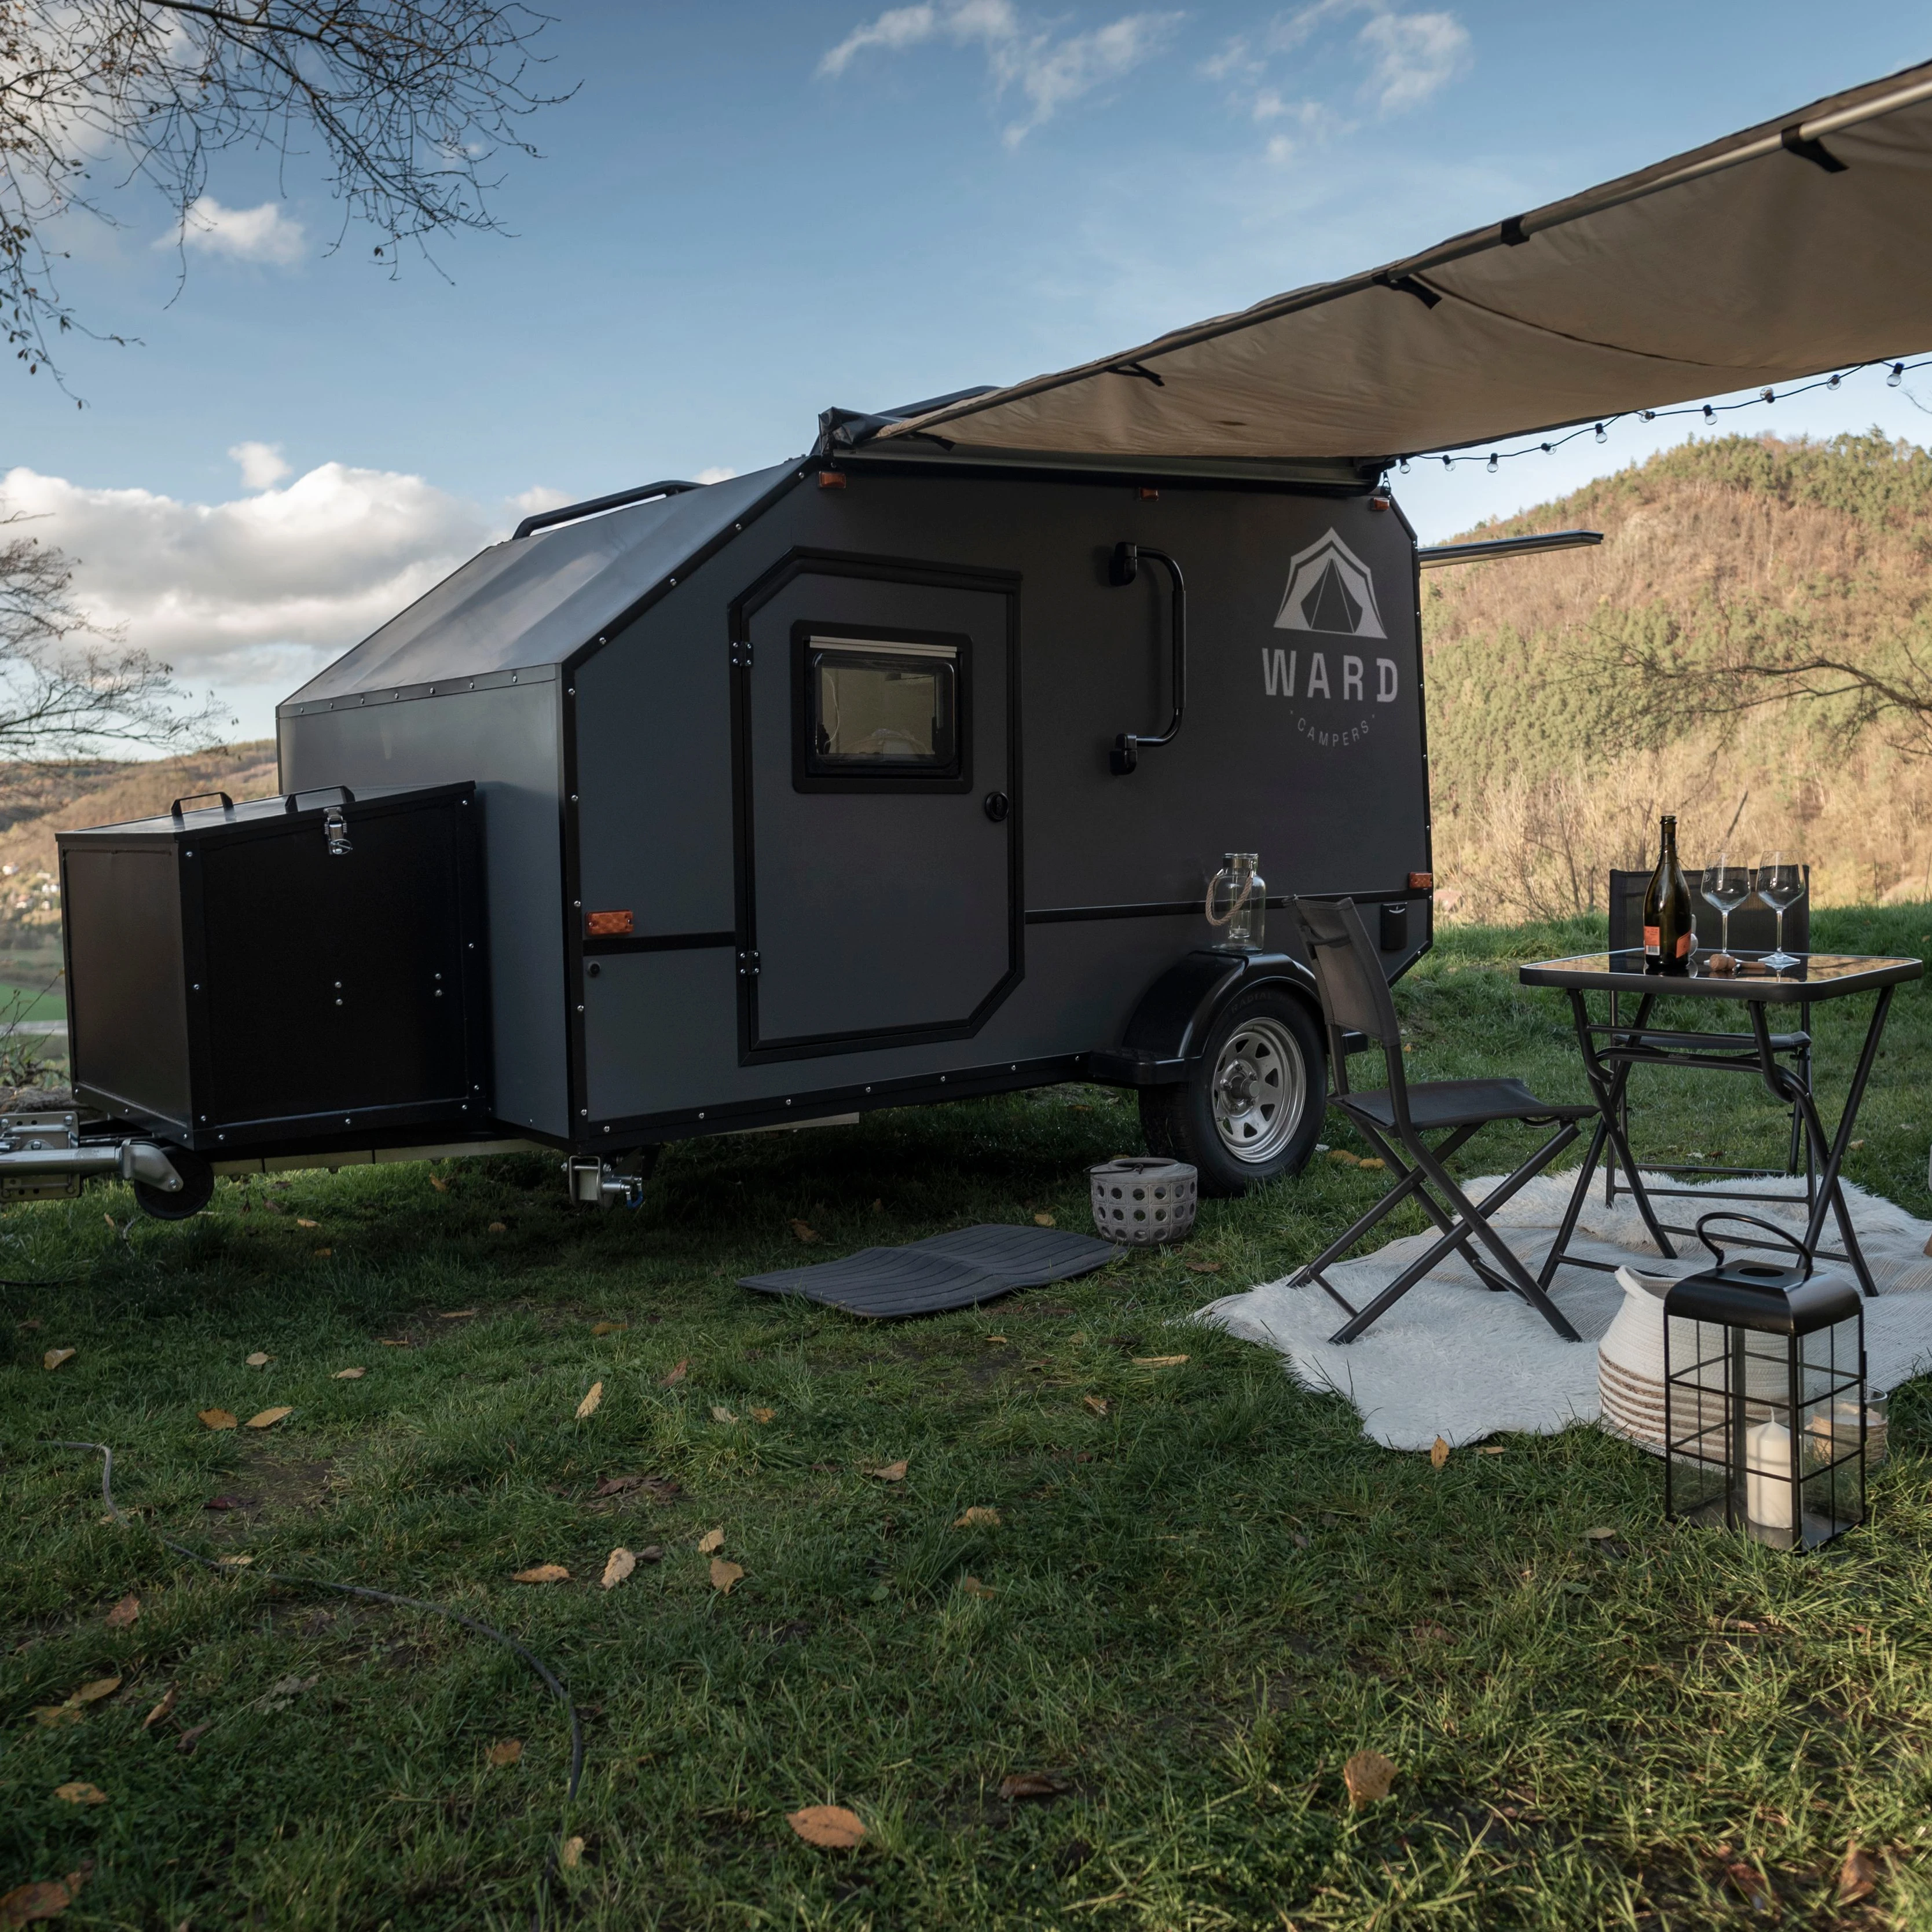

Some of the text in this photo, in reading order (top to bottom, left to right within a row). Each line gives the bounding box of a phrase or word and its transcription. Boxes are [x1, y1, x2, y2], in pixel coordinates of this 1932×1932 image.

[1262, 648, 1398, 702] WARD
[1297, 717, 1369, 747] CAMPERS
[1231, 992, 1273, 1014] RADIAL
